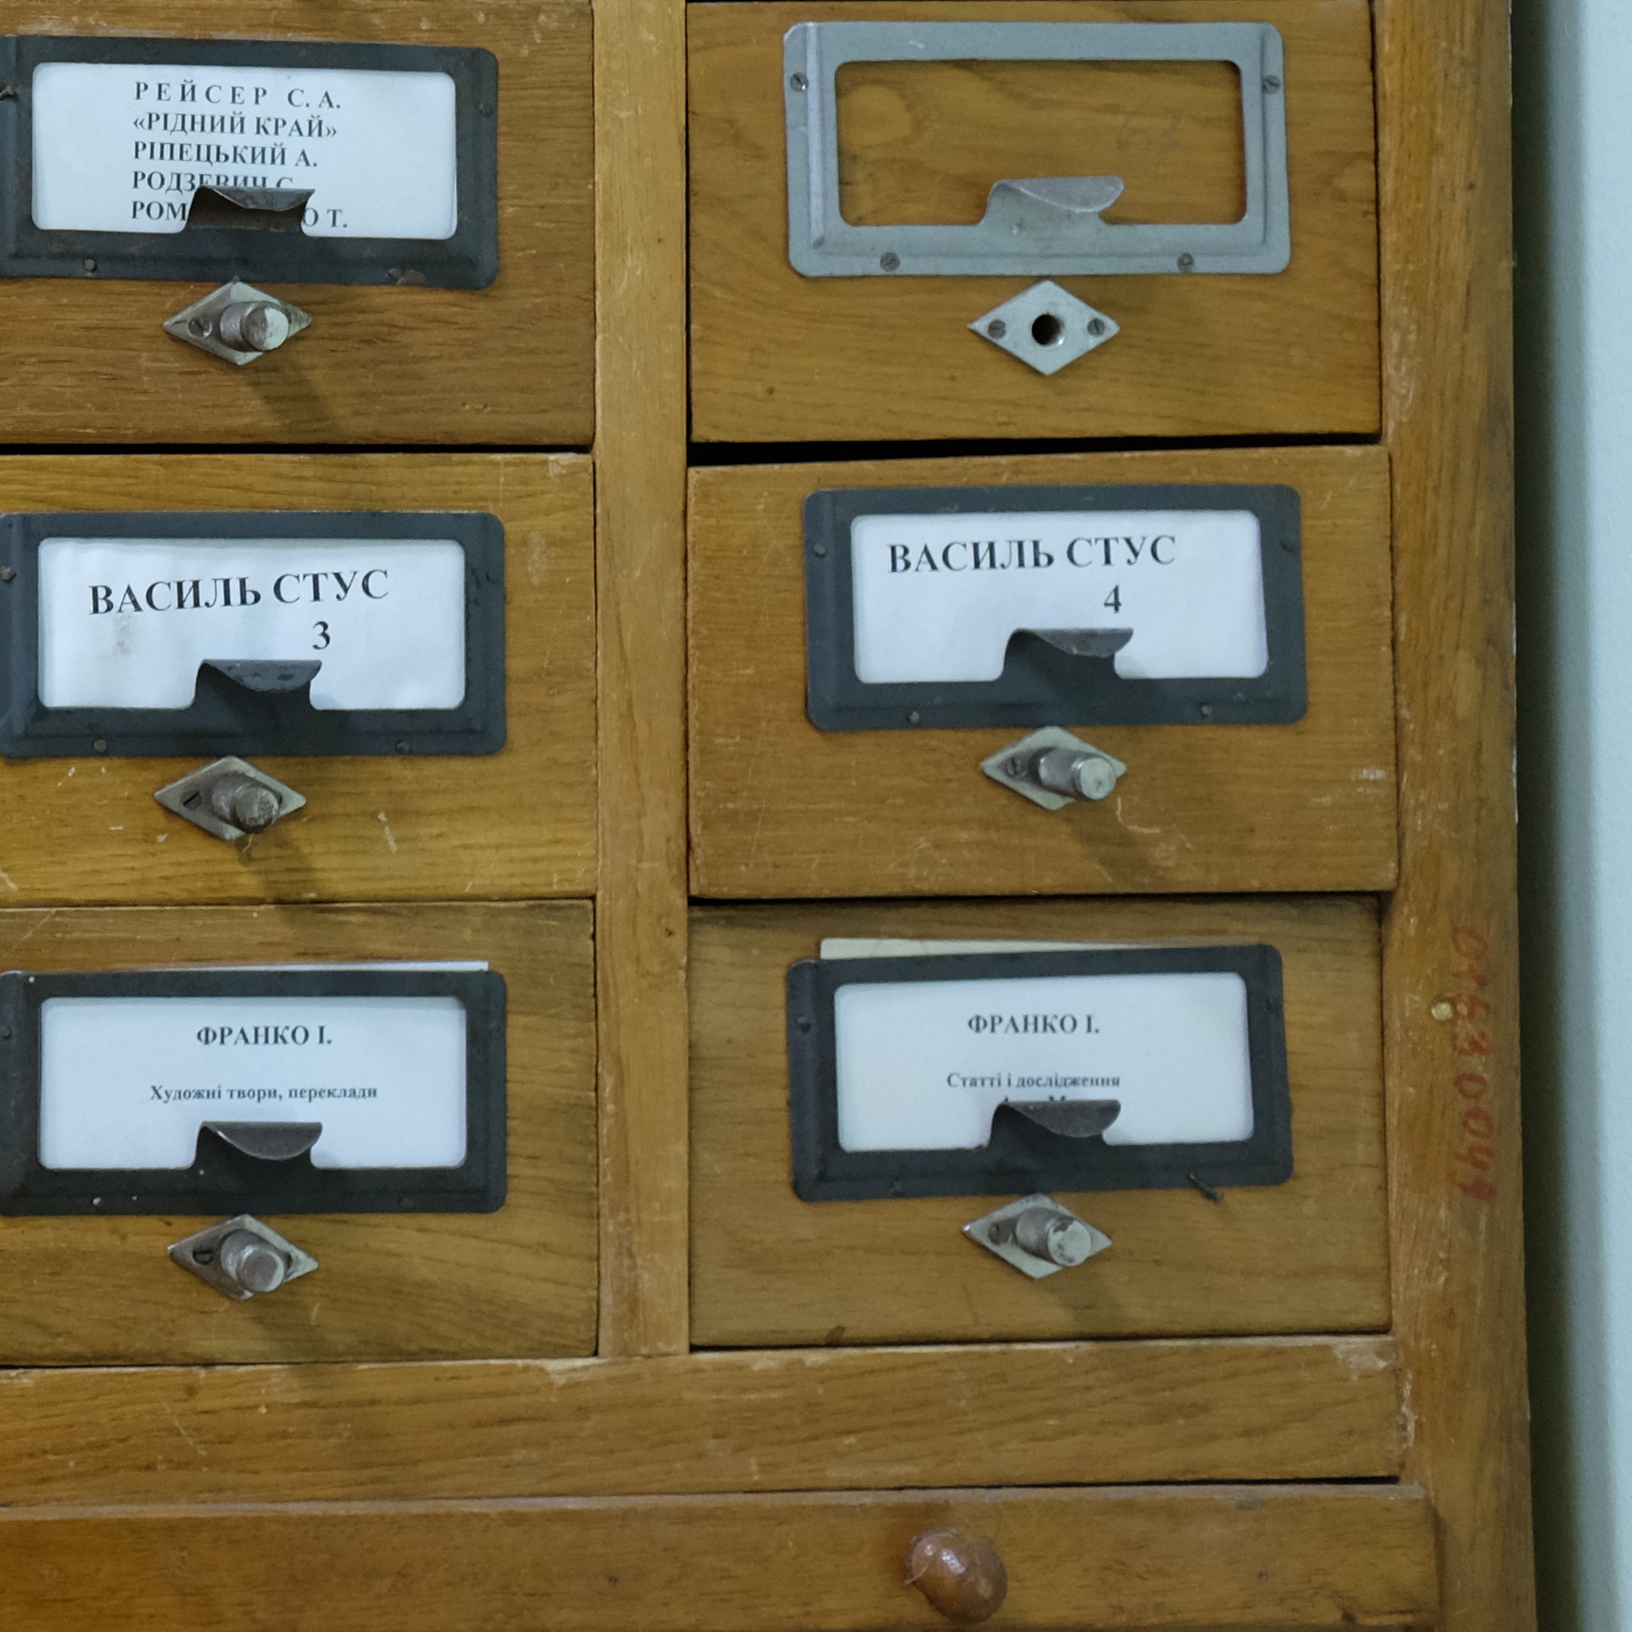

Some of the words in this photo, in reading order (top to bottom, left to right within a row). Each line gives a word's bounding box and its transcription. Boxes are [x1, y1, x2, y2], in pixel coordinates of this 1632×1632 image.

[287, 88, 310, 108] С.
[318, 90, 341, 109] А.
[133, 110, 245, 135] «РІДНИЙ
[255, 114, 337, 138] КРАЙ»
[134, 140, 286, 167] РІПЕЦЬКИЙ
[294, 148, 318, 168] А.
[326, 209, 348, 229] Т.
[889, 539, 1055, 573] ВАСИЛЬ
[1066, 535, 1176, 567] СТУС
[90, 576, 262, 615] ВАСИЛЬ
[272, 569, 388, 604] СТУС
[1103, 584, 1122, 614] 4
[312, 620, 331, 651] 3
[196, 1025, 310, 1046] ФРАНКО
[318, 1025, 332, 1045] І.
[967, 1014, 1078, 1034] ФРАНКО
[1086, 1014, 1100, 1034] І.
[946, 1072, 1002, 1089] Статті
[1006, 1072, 1012, 1088] і
[1014, 1072, 1121, 1090] дослідження
[150, 1084, 222, 1104] Художні
[227, 1088, 283, 1104] твори,
[288, 1087, 378, 1104] переклади
